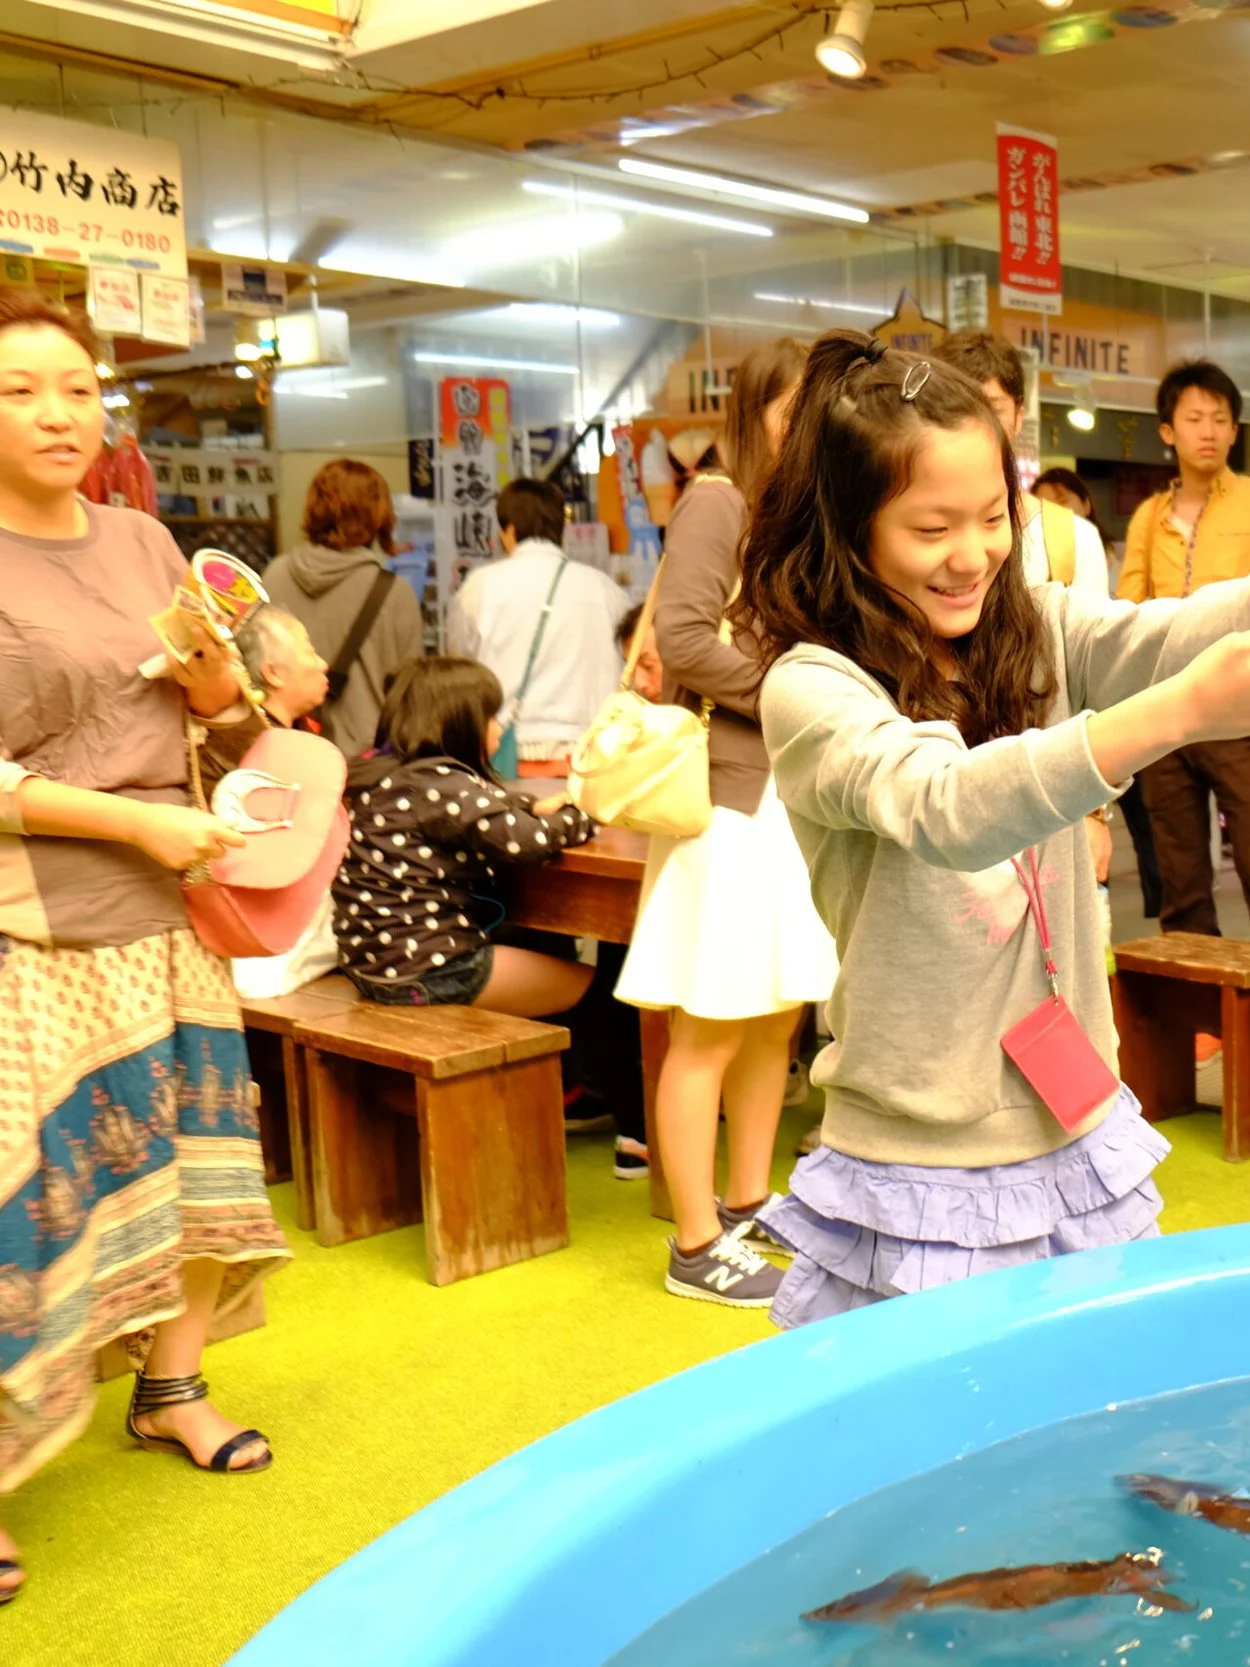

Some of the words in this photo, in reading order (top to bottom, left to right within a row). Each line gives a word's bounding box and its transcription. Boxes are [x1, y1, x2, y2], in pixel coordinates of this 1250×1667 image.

[10, 151, 180, 217] 竹内商店
[1021, 328, 1129, 375] INFINITE
